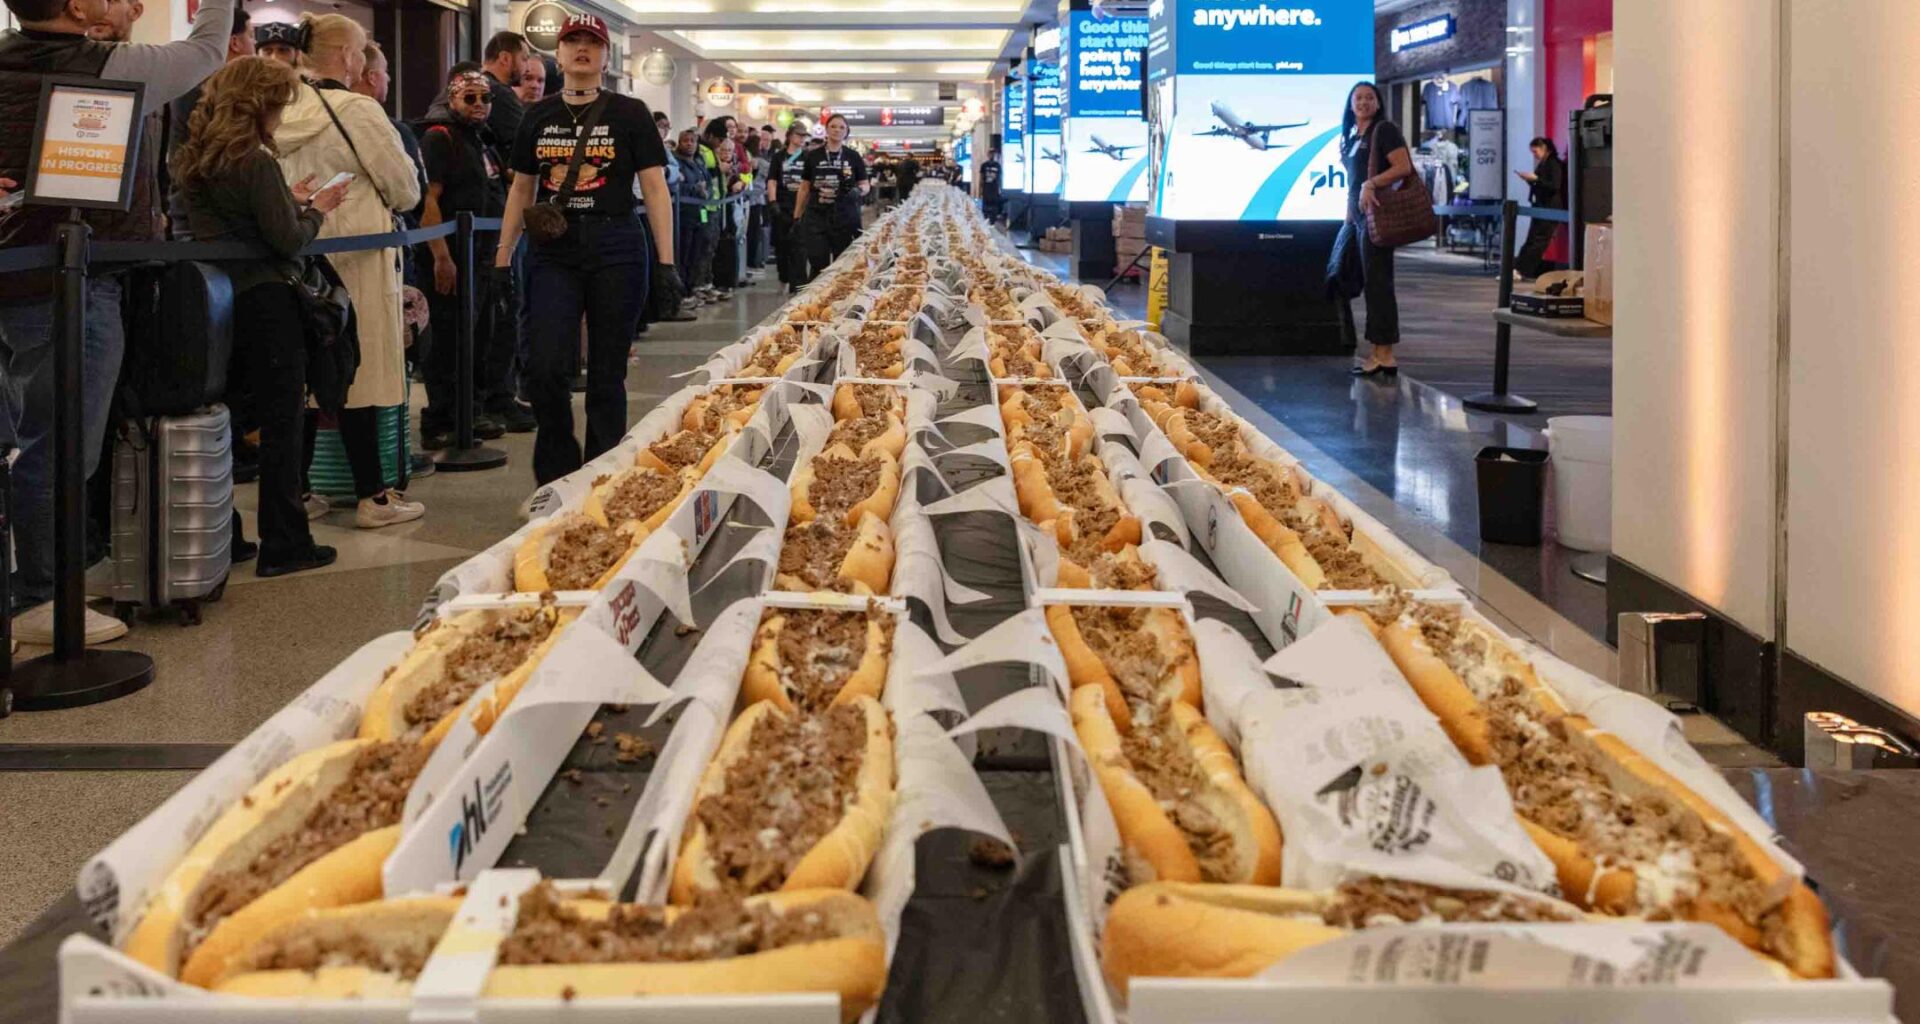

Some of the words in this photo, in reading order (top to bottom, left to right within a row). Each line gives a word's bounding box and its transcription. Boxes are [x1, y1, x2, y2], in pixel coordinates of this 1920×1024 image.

[569, 14, 601, 30] PHL
[1193, 4, 1322, 31] anywhere.
[1080, 20, 1120, 34] Good
[1121, 20, 1149, 34] thin
[1079, 35, 1114, 48] start
[1116, 35, 1149, 48] with
[1079, 49, 1122, 64] going
[1123, 49, 1141, 62] fr
[1080, 62, 1113, 76] here
[1114, 64, 1131, 76] to
[1214, 61, 1237, 71] things
[1237, 61, 1255, 70] start
[1275, 61, 1304, 71] phl.org
[1079, 77, 1142, 93] anywher
[537, 138, 578, 147] LONGEST
[601, 138, 615, 146] OF
[57, 146, 113, 159] HISTORY
[536, 146, 616, 159] CHEESEEAKS
[40, 158, 57, 169] IN
[58, 159, 124, 173] PROGRESS
[1477, 156, 1496, 165] OFF
[1310, 164, 1346, 196] ph
